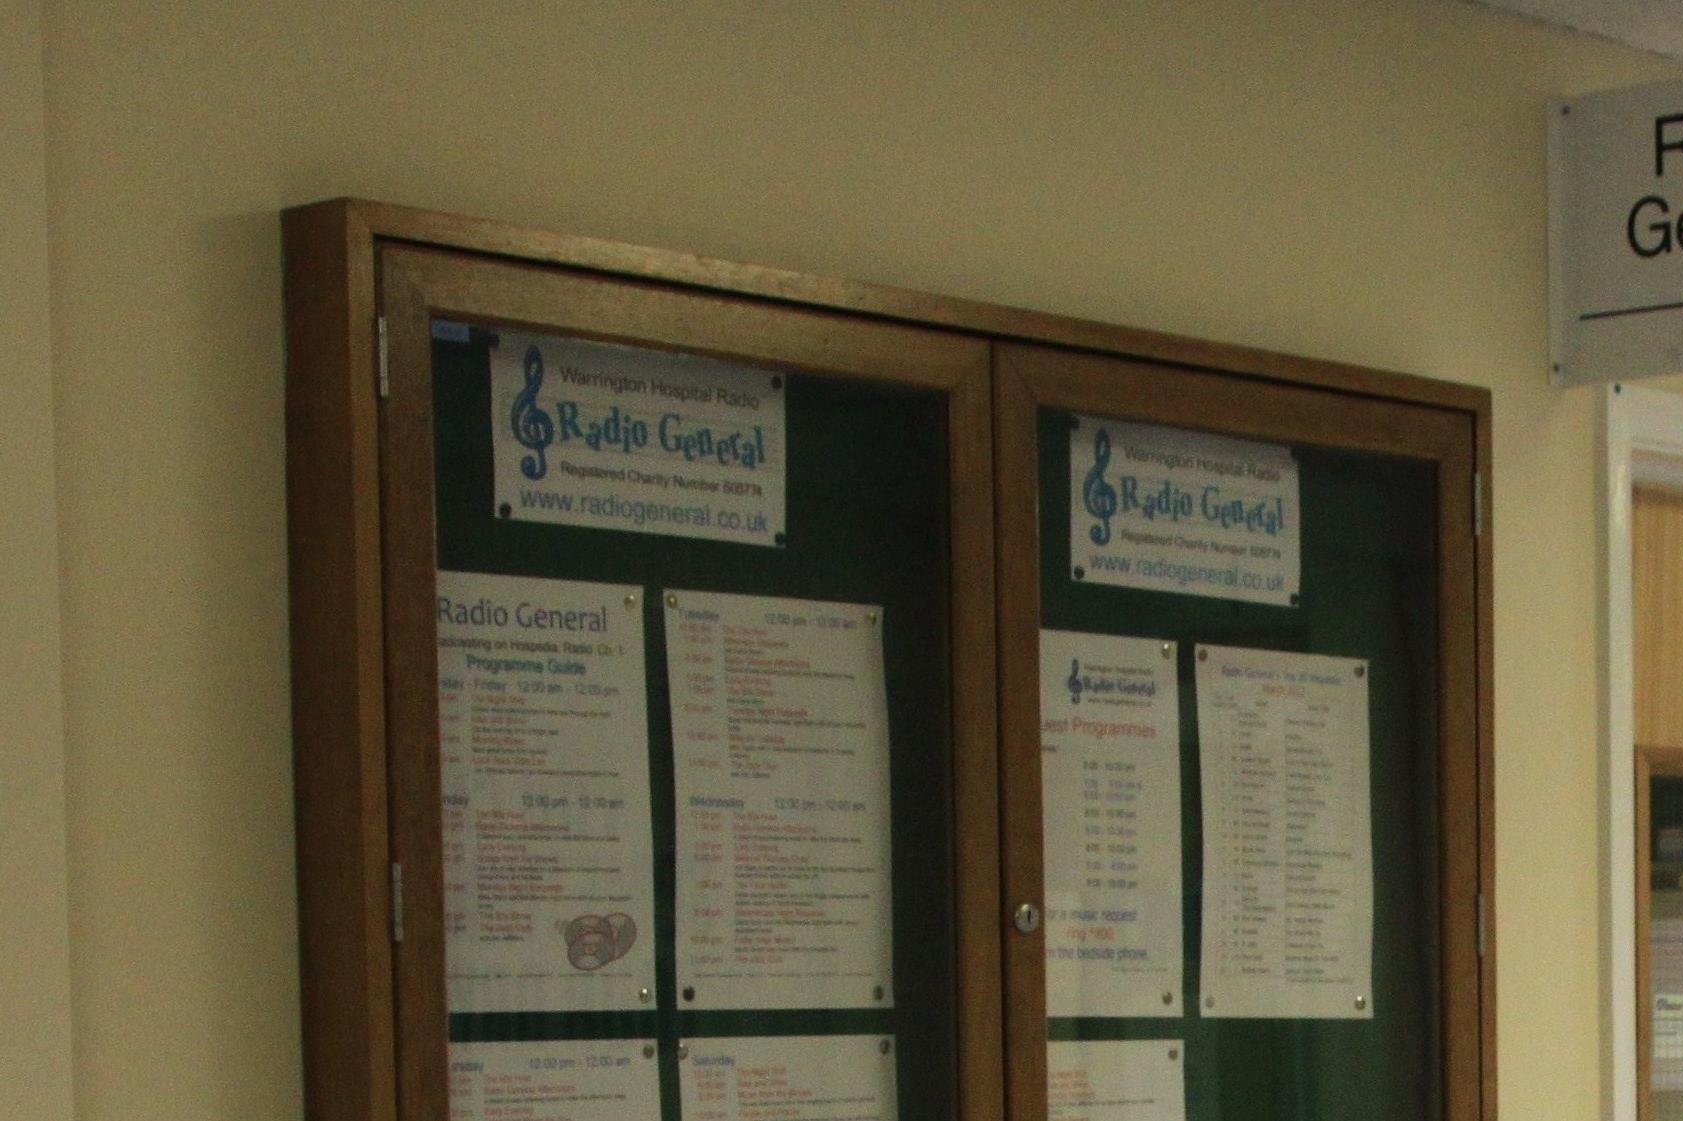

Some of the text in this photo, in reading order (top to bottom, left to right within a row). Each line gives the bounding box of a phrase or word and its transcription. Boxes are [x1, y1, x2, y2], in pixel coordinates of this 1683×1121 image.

[559, 366, 760, 411] Warrington Hospital Radio
[556, 401, 766, 470] Radio General
[560, 460, 626, 480] Registered
[627, 469, 670, 490] Charity
[672, 474, 720, 493] Number
[520, 488, 769, 533] www.radiogeneral.co.uk
[1120, 475, 1284, 537] Radio General
[1090, 555, 1285, 592] www.radiogeneral.co.uk
[437, 598, 608, 632] Radio General
[466, 654, 587, 676] Programme Guide
[1072, 715, 1157, 741] Programmes
[691, 1053, 736, 1067] Saturday
